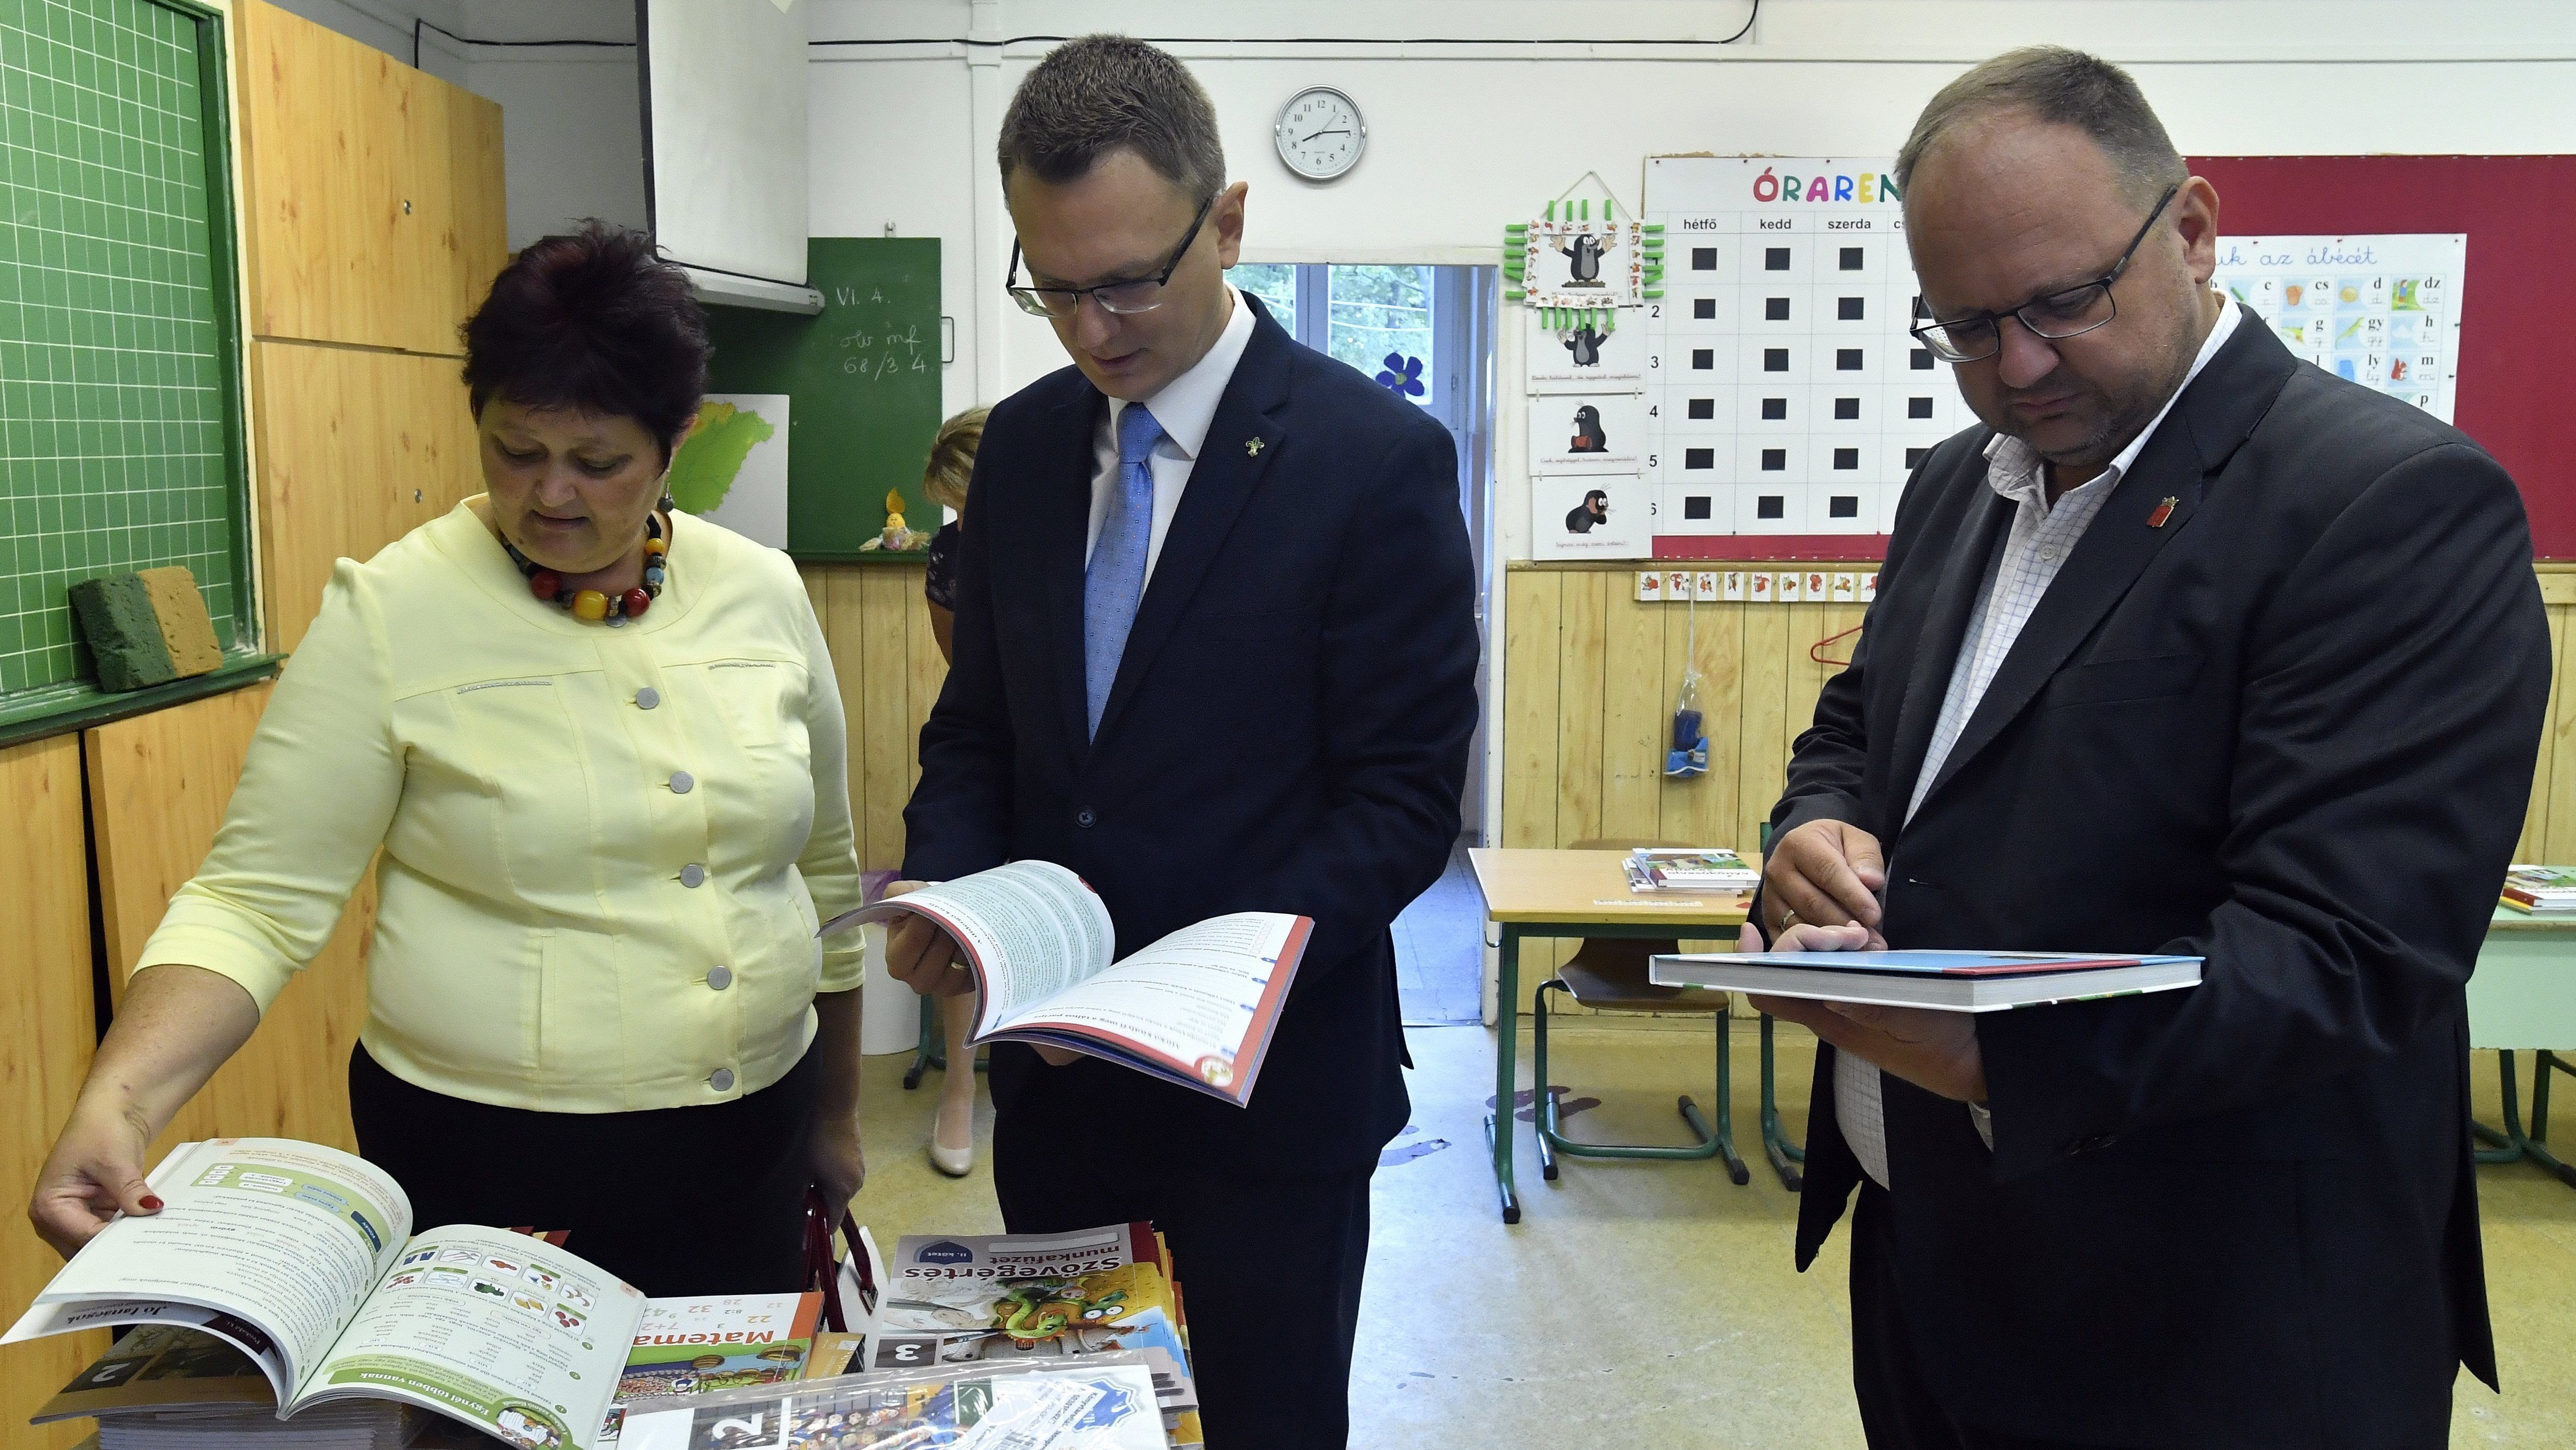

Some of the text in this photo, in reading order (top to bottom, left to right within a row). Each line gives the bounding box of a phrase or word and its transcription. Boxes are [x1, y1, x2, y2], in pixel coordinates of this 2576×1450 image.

[1329, 154, 1334, 162] 5
[1683, 219, 1716, 229] hétfő
[1760, 219, 1792, 229] kedd
[1828, 218, 1871, 229] szerda
[2307, 246, 2377, 265] ábécét
[2264, 281, 2271, 290] c
[2315, 281, 2328, 290] cs
[2374, 278, 2381, 289] d
[2425, 277, 2440, 289] dz
[1651, 305, 1660, 318] 2
[2316, 319, 2323, 331] g
[2368, 318, 2384, 331] gy
[2425, 315, 2433, 327] h
[911, 354, 926, 374] 4
[1651, 355, 1659, 369] 3
[2368, 354, 2381, 369] ly
[2421, 356, 2434, 366] m
[2420, 394, 2429, 407] p
[1649, 405, 1659, 417] 4
[1649, 455, 1658, 467] 5
[989, 1246, 1119, 1265] munkafüzet
[904, 1256, 1120, 1282] Szövegértés
[688, 1305, 714, 1314] 32
[747, 1315, 773, 1323] 22
[895, 1343, 922, 1361] 3
[91, 1362, 131, 1382] 2
[359, 1372, 489, 1415] Egynél többen vannak
